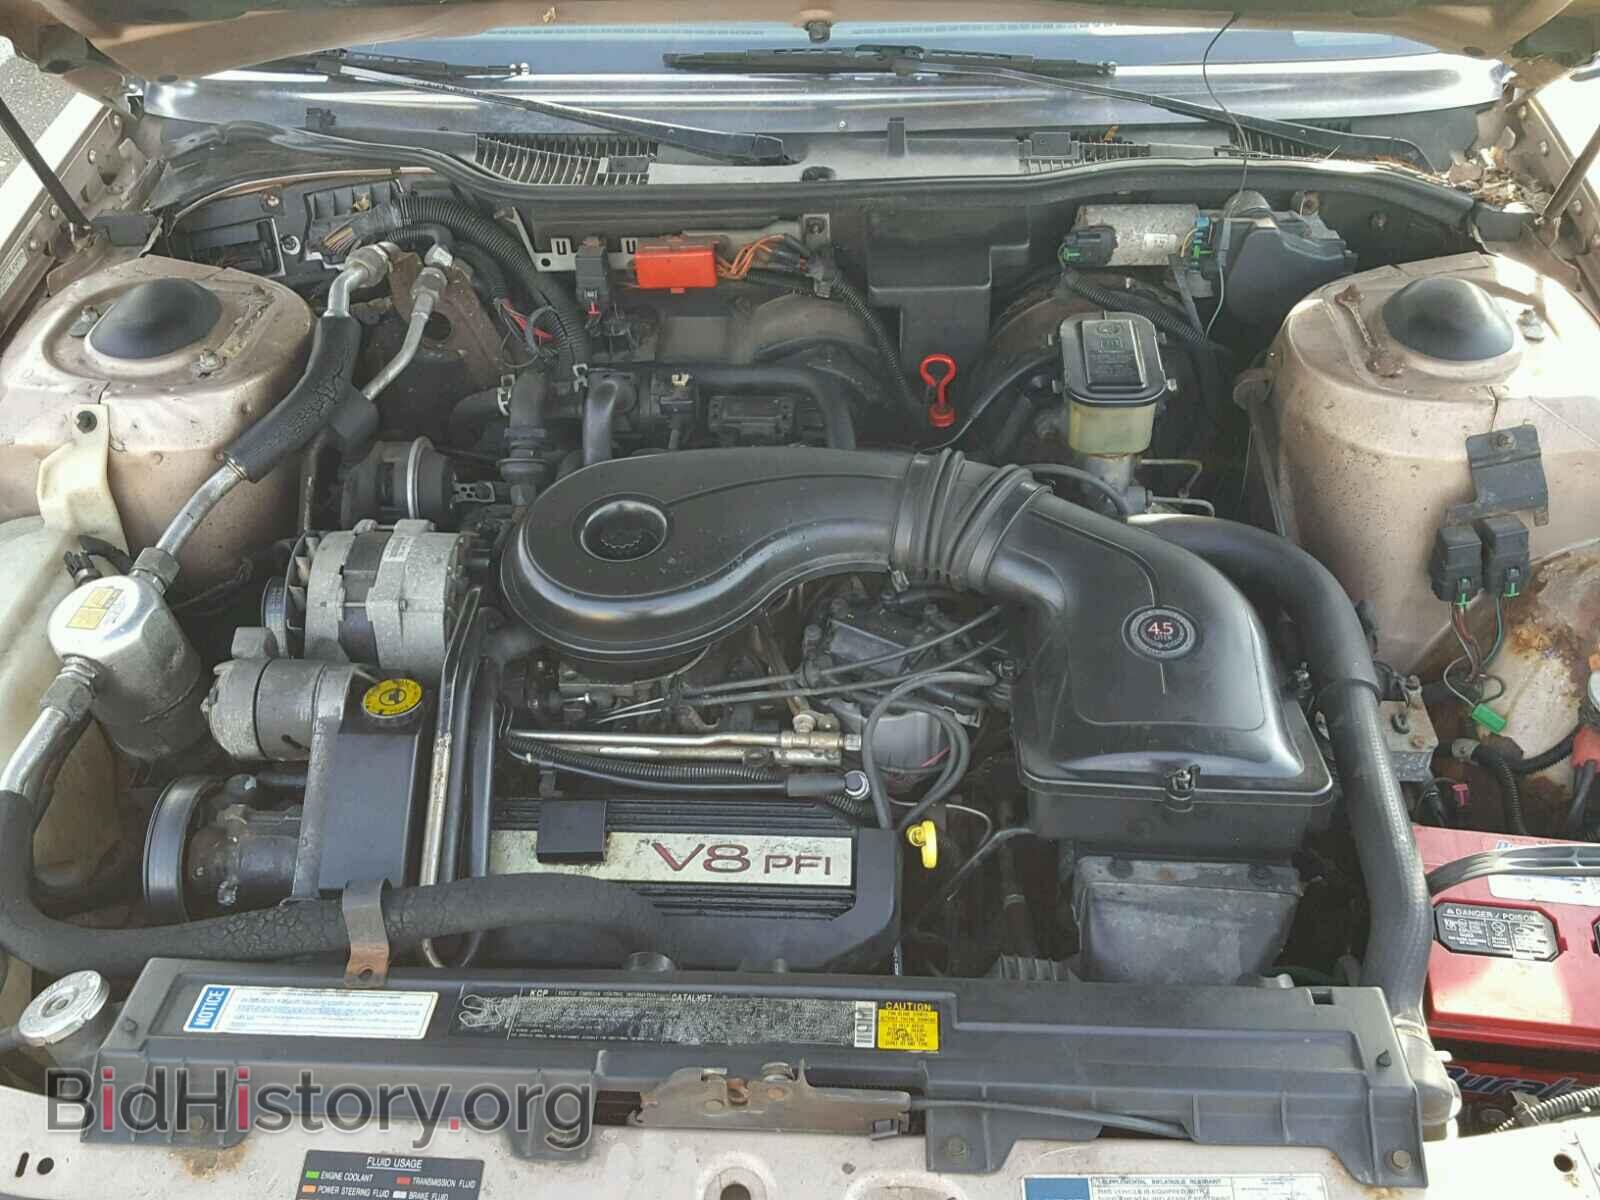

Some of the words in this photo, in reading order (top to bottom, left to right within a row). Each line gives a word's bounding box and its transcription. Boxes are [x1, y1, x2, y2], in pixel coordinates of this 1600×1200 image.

[651, 842, 751, 873] V8
[763, 854, 832, 875] PFI
[1455, 907, 1494, 918] DANGER
[1502, 911, 1538, 921] POISON
[195, 990, 226, 1026] NOTICE
[885, 1000, 933, 1012] CAUTION
[366, 1156, 391, 1167] FLUID
[393, 1157, 424, 1169] USAGE
[320, 1170, 343, 1181] ENGINE
[343, 1171, 374, 1183] COOLANT
[411, 1176, 457, 1188] TRANSMISSION
[458, 1178, 477, 1189] FLUID
[317, 1185, 340, 1196] POWER
[341, 1186, 371, 1198] STEERING
[372, 1187, 391, 1198] FLUID
[408, 1190, 430, 1200] BRAKE
[431, 1191, 449, 1200] FLUID
